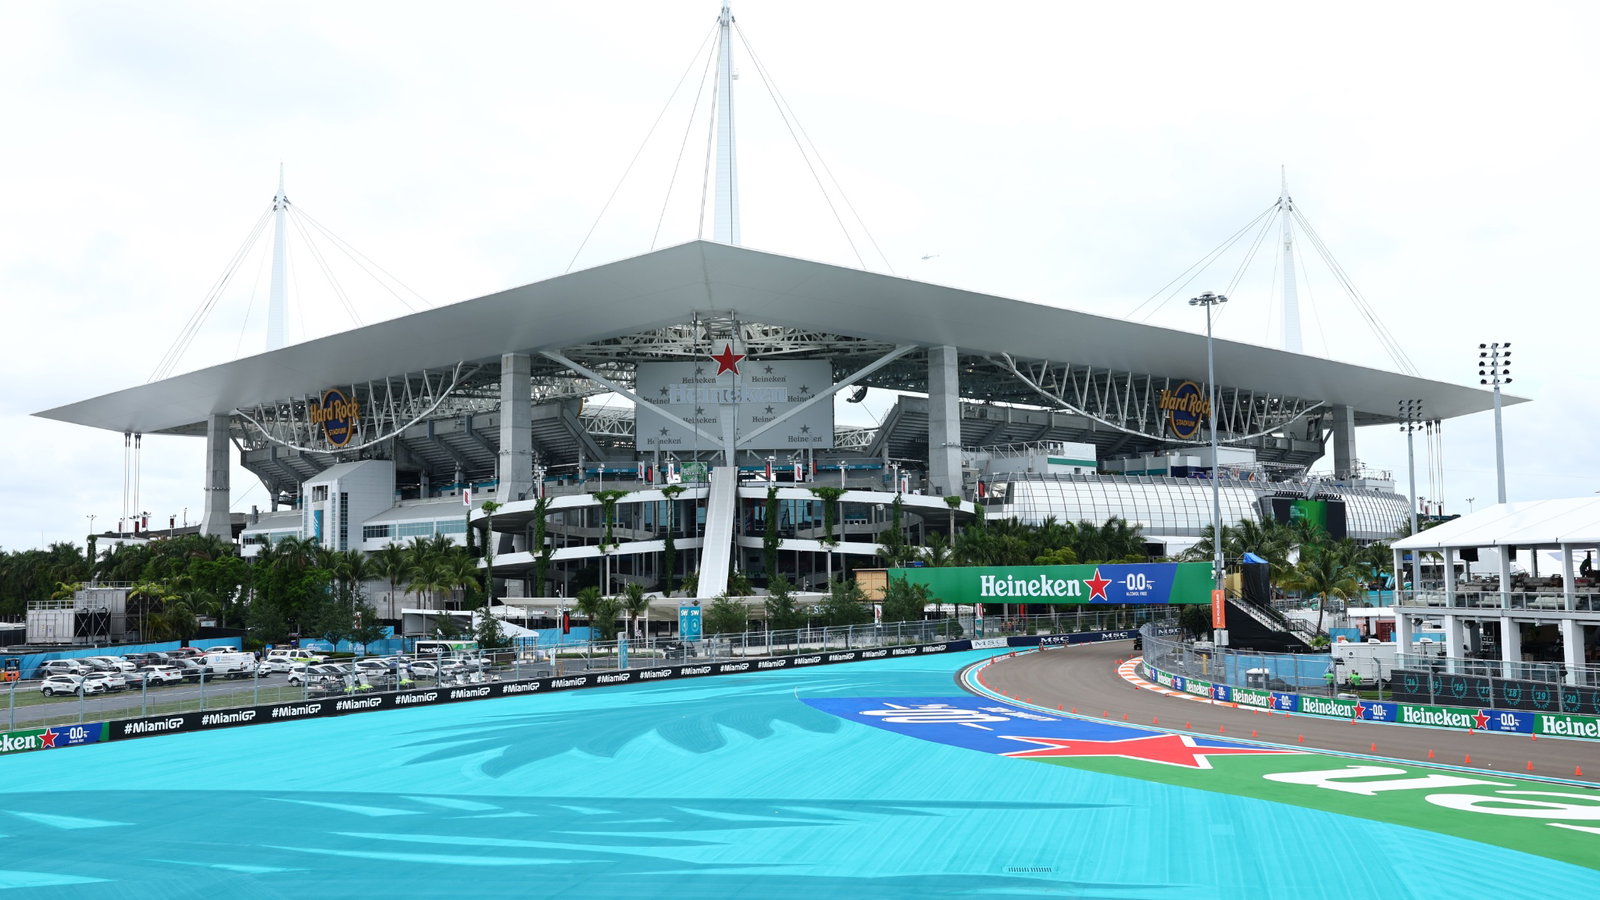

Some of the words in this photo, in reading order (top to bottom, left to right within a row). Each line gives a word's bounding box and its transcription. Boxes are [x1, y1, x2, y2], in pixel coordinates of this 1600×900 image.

[1160, 389, 1189, 411] Hard
[310, 402, 333, 423] Hard
[334, 397, 360, 423] Rock
[980, 574, 1081, 597] Heineken
[597, 673, 630, 683] #MiamiGP
[640, 669, 672, 679] #MiamiGP
[503, 682, 540, 693] #MiamiGP
[551, 677, 586, 688] #MiamiGP
[396, 692, 437, 704] #MiamiGP
[451, 687, 490, 698] #MiamiGP
[1233, 689, 1267, 706] Heineken
[1507, 688, 1517, 698] '18
[1535, 691, 1547, 700] '19
[1565, 695, 1576, 703] '20
[336, 697, 382, 710] #MiamiGP
[1303, 697, 1352, 717] Heineken
[202, 710, 256, 725] #MiamiGP
[272, 704, 321, 718] #MiamiGP
[1403, 706, 1472, 727] Heineken
[124, 718, 184, 734] #MiamiGP
